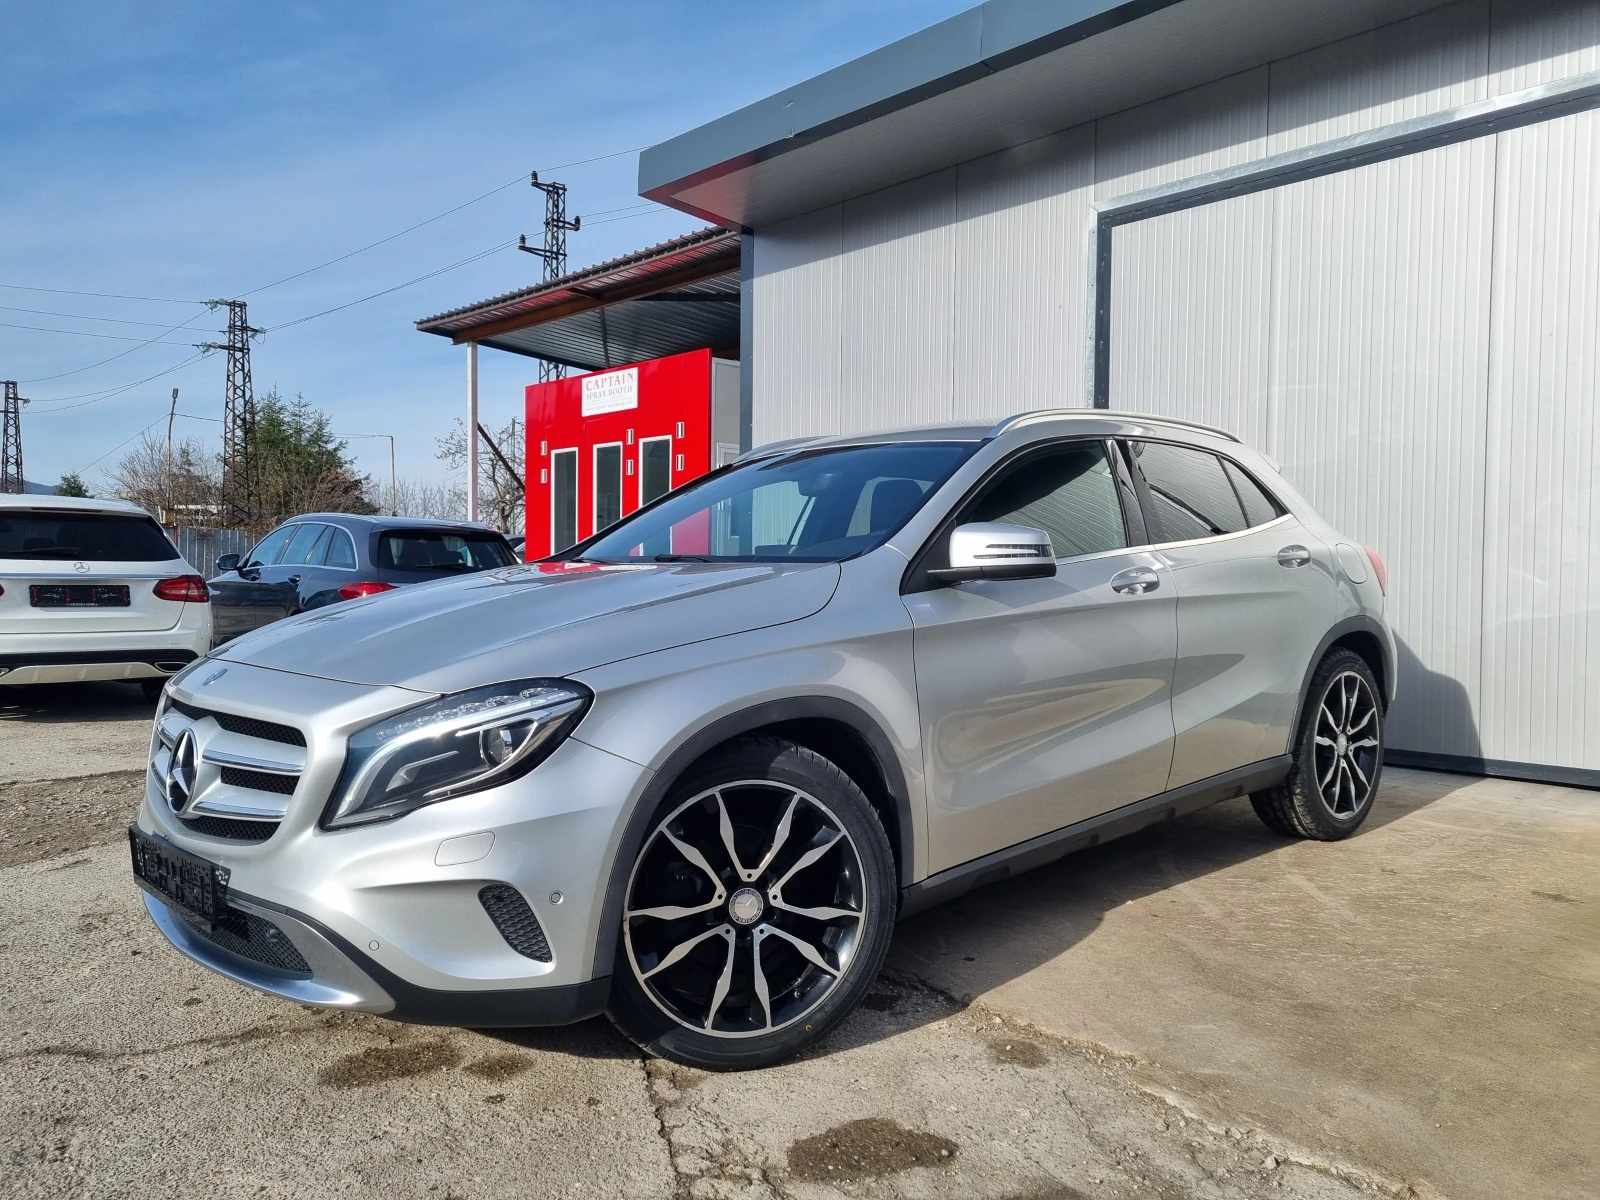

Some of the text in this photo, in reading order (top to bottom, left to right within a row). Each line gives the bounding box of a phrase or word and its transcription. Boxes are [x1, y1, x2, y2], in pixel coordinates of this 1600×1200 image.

[586, 372, 634, 391] CAPTAIN
[586, 385, 633, 400] SPRAY BOOTH
